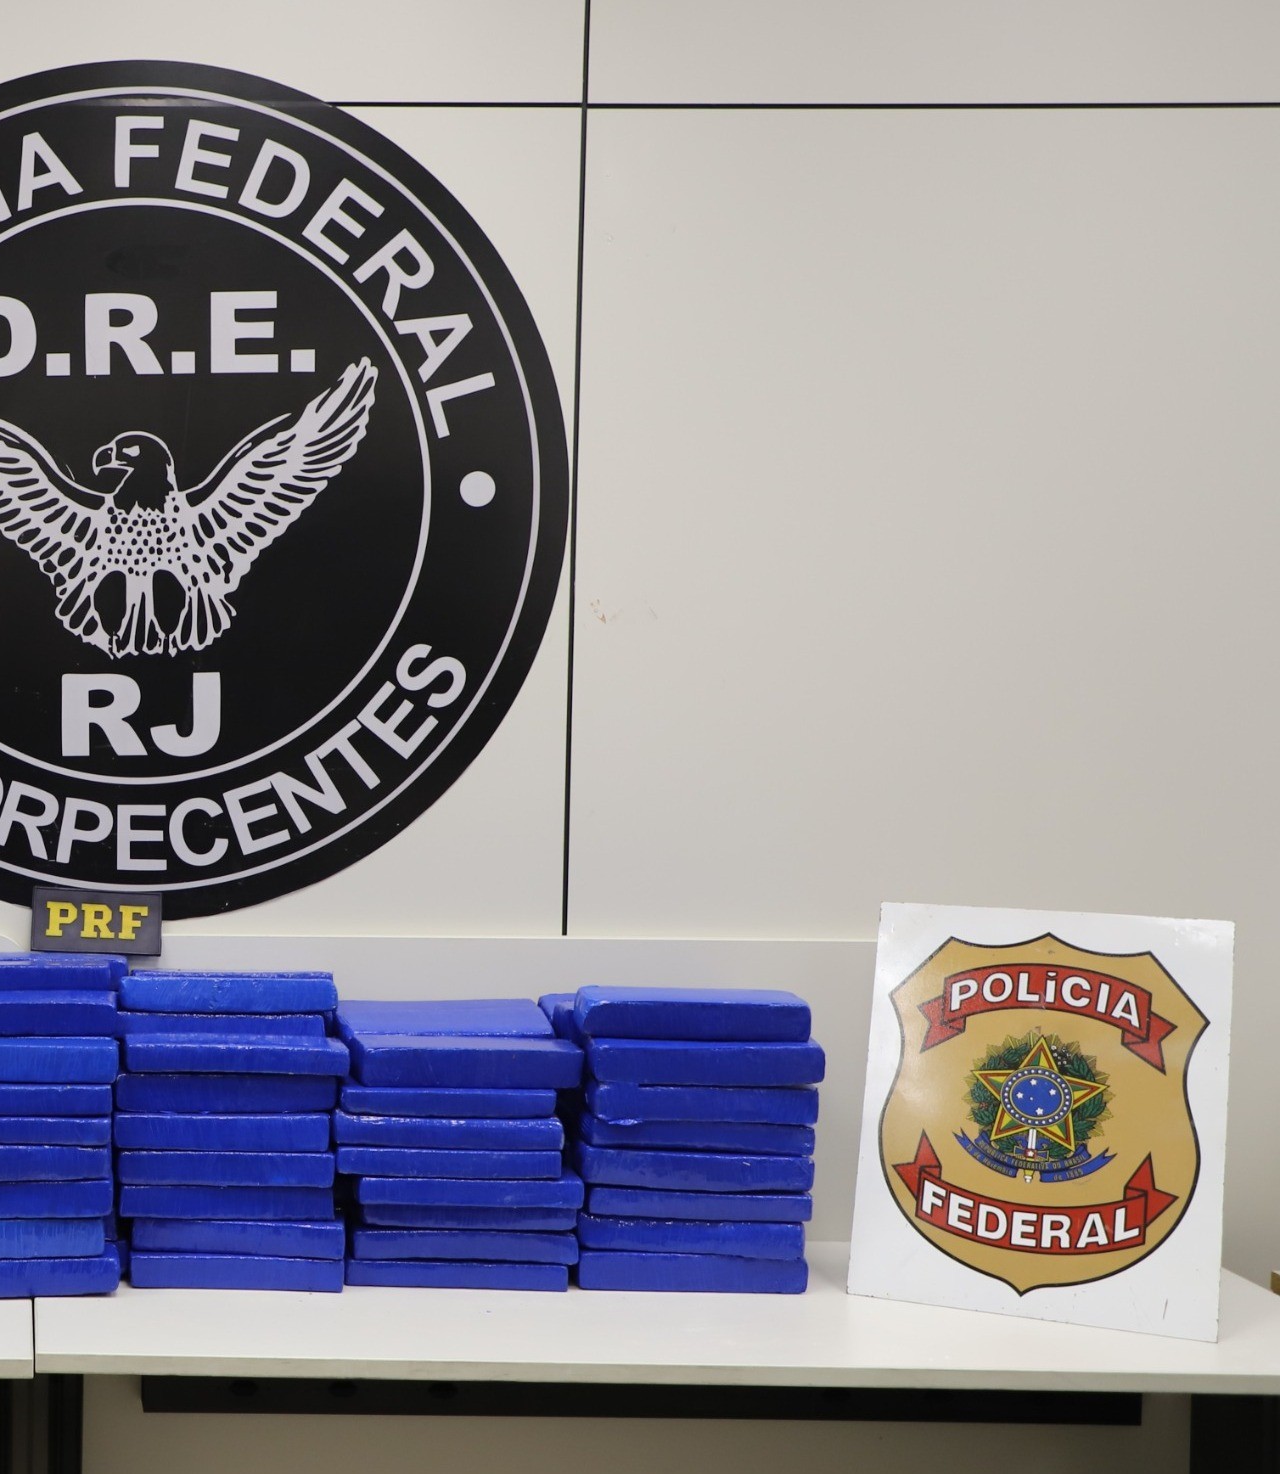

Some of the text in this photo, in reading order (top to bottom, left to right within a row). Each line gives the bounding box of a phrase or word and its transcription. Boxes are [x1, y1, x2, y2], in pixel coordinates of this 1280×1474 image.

[114, 115, 496, 439] FEDERAL
[61, 671, 222, 758] RJ
[45, 901, 149, 940] PRF
[921, 1179, 1141, 1249] FEDERAL
